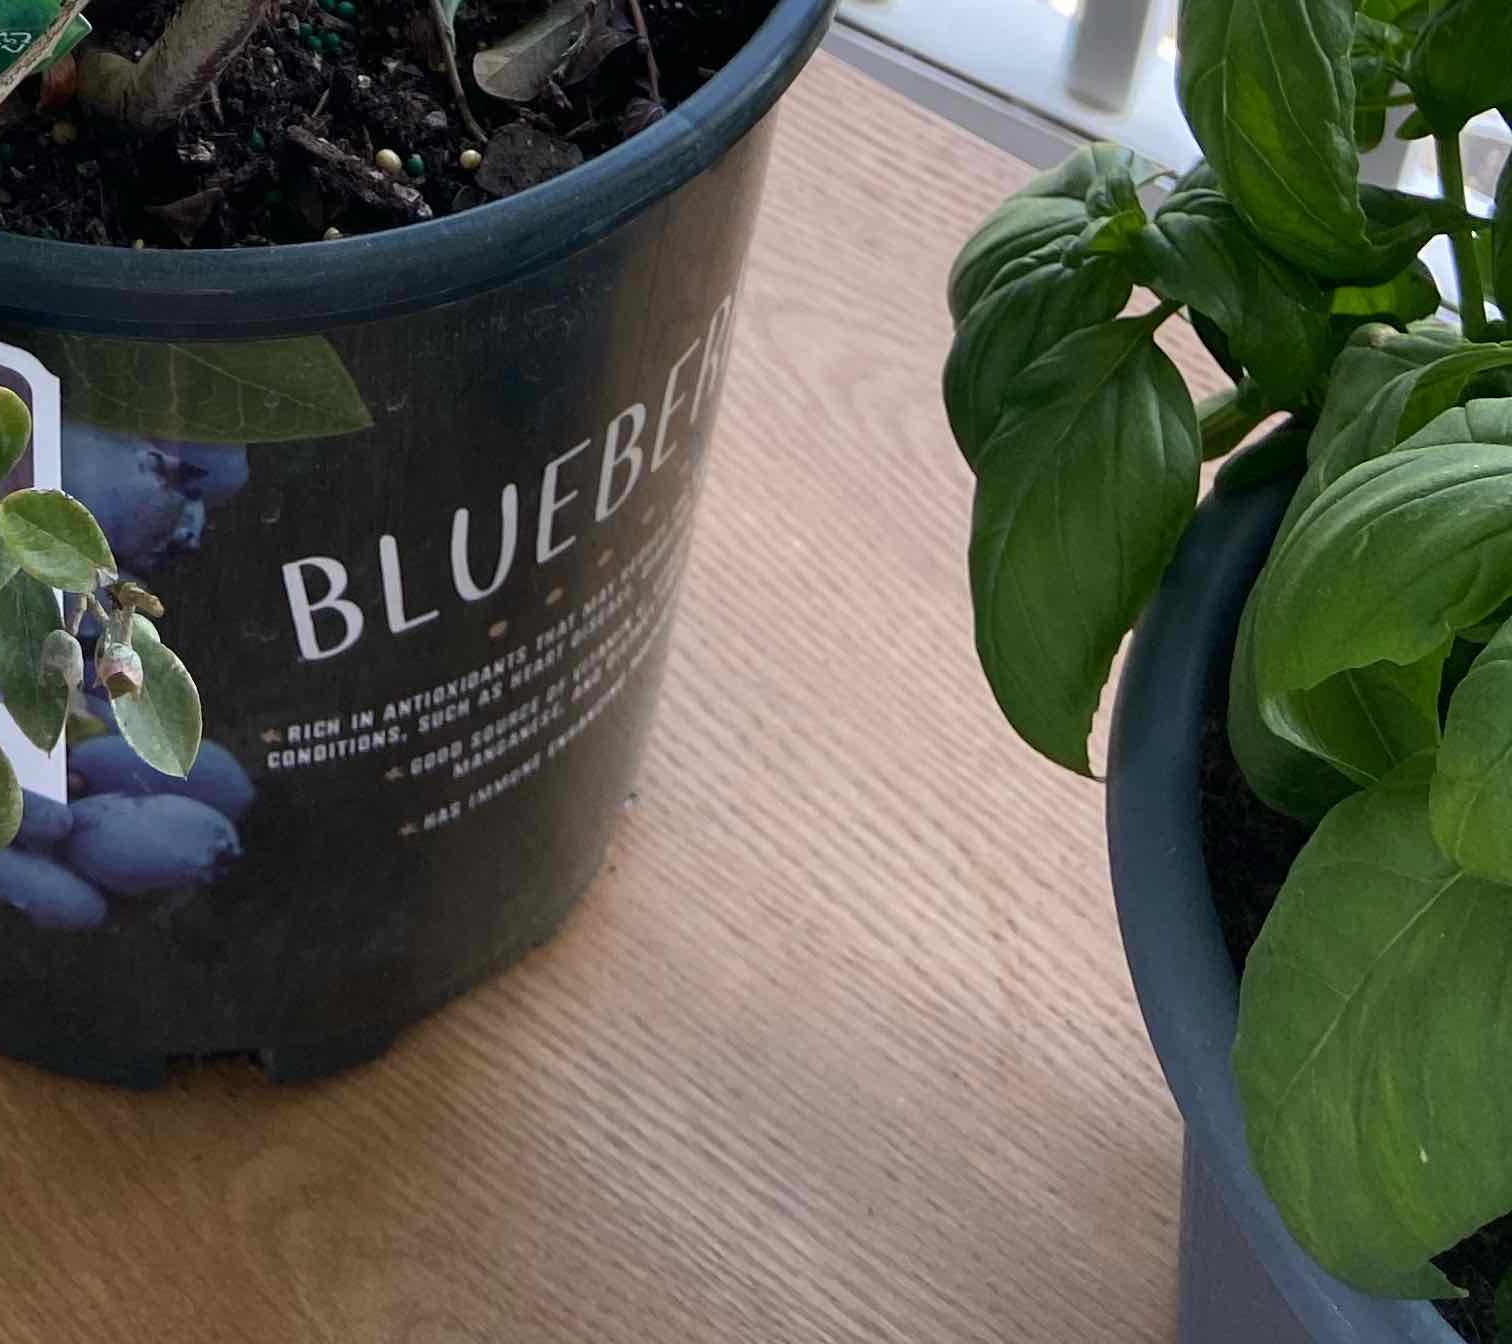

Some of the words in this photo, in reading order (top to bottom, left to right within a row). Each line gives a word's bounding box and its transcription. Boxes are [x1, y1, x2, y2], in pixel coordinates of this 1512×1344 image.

[283, 295, 731, 662] BLUEBER
[288, 718, 341, 744] RICH
[351, 709, 375, 731] IN
[382, 645, 528, 722] ANTIOXIDANTS
[535, 611, 575, 652] THAT
[266, 725, 408, 770] CONDITIONS,
[417, 698, 471, 734] SUCH
[477, 680, 504, 708] AS
[409, 740, 464, 777] GOOD
[469, 695, 539, 751] SOURCE
[422, 800, 461, 831] HAS
